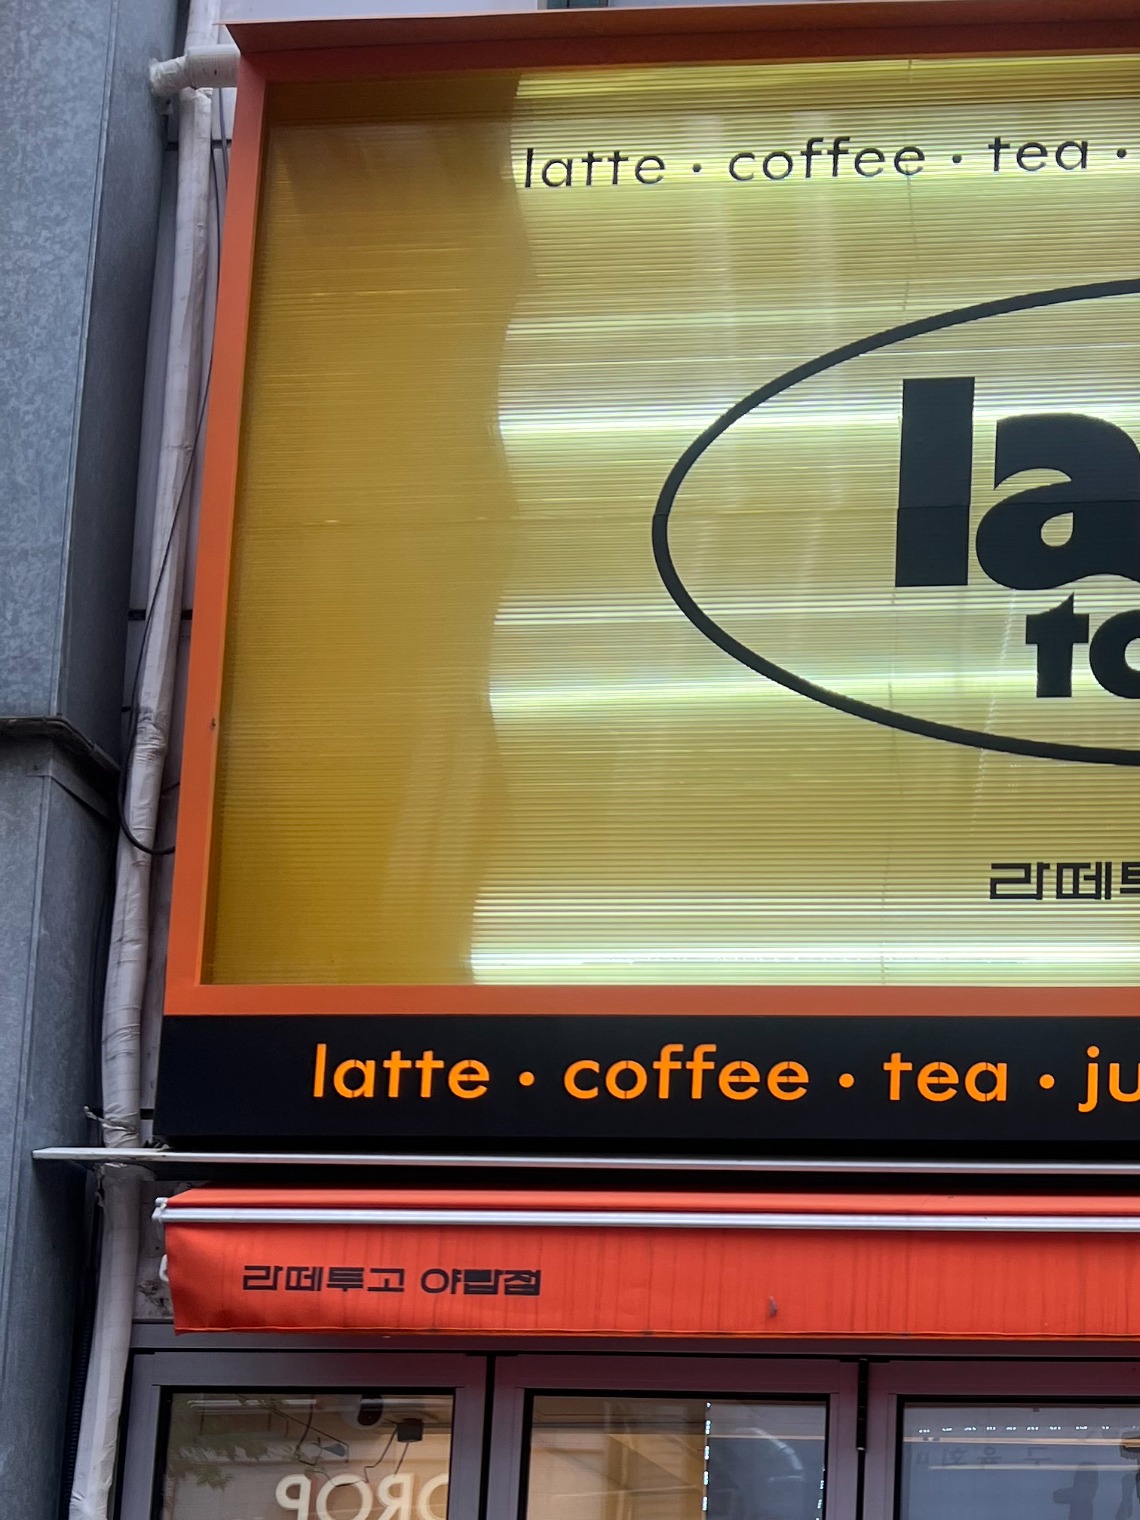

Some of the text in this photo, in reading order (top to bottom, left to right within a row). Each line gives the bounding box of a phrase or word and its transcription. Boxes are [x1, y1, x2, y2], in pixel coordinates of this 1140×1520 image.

[524, 147, 666, 188] latte
[728, 136, 925, 183] coffee
[987, 134, 1089, 173] tea
[313, 1043, 490, 1099] latte
[563, 1043, 810, 1101] coffee
[882, 1053, 1008, 1102] tea
[242, 1264, 542, 1297] 라떼투고 야탑점
